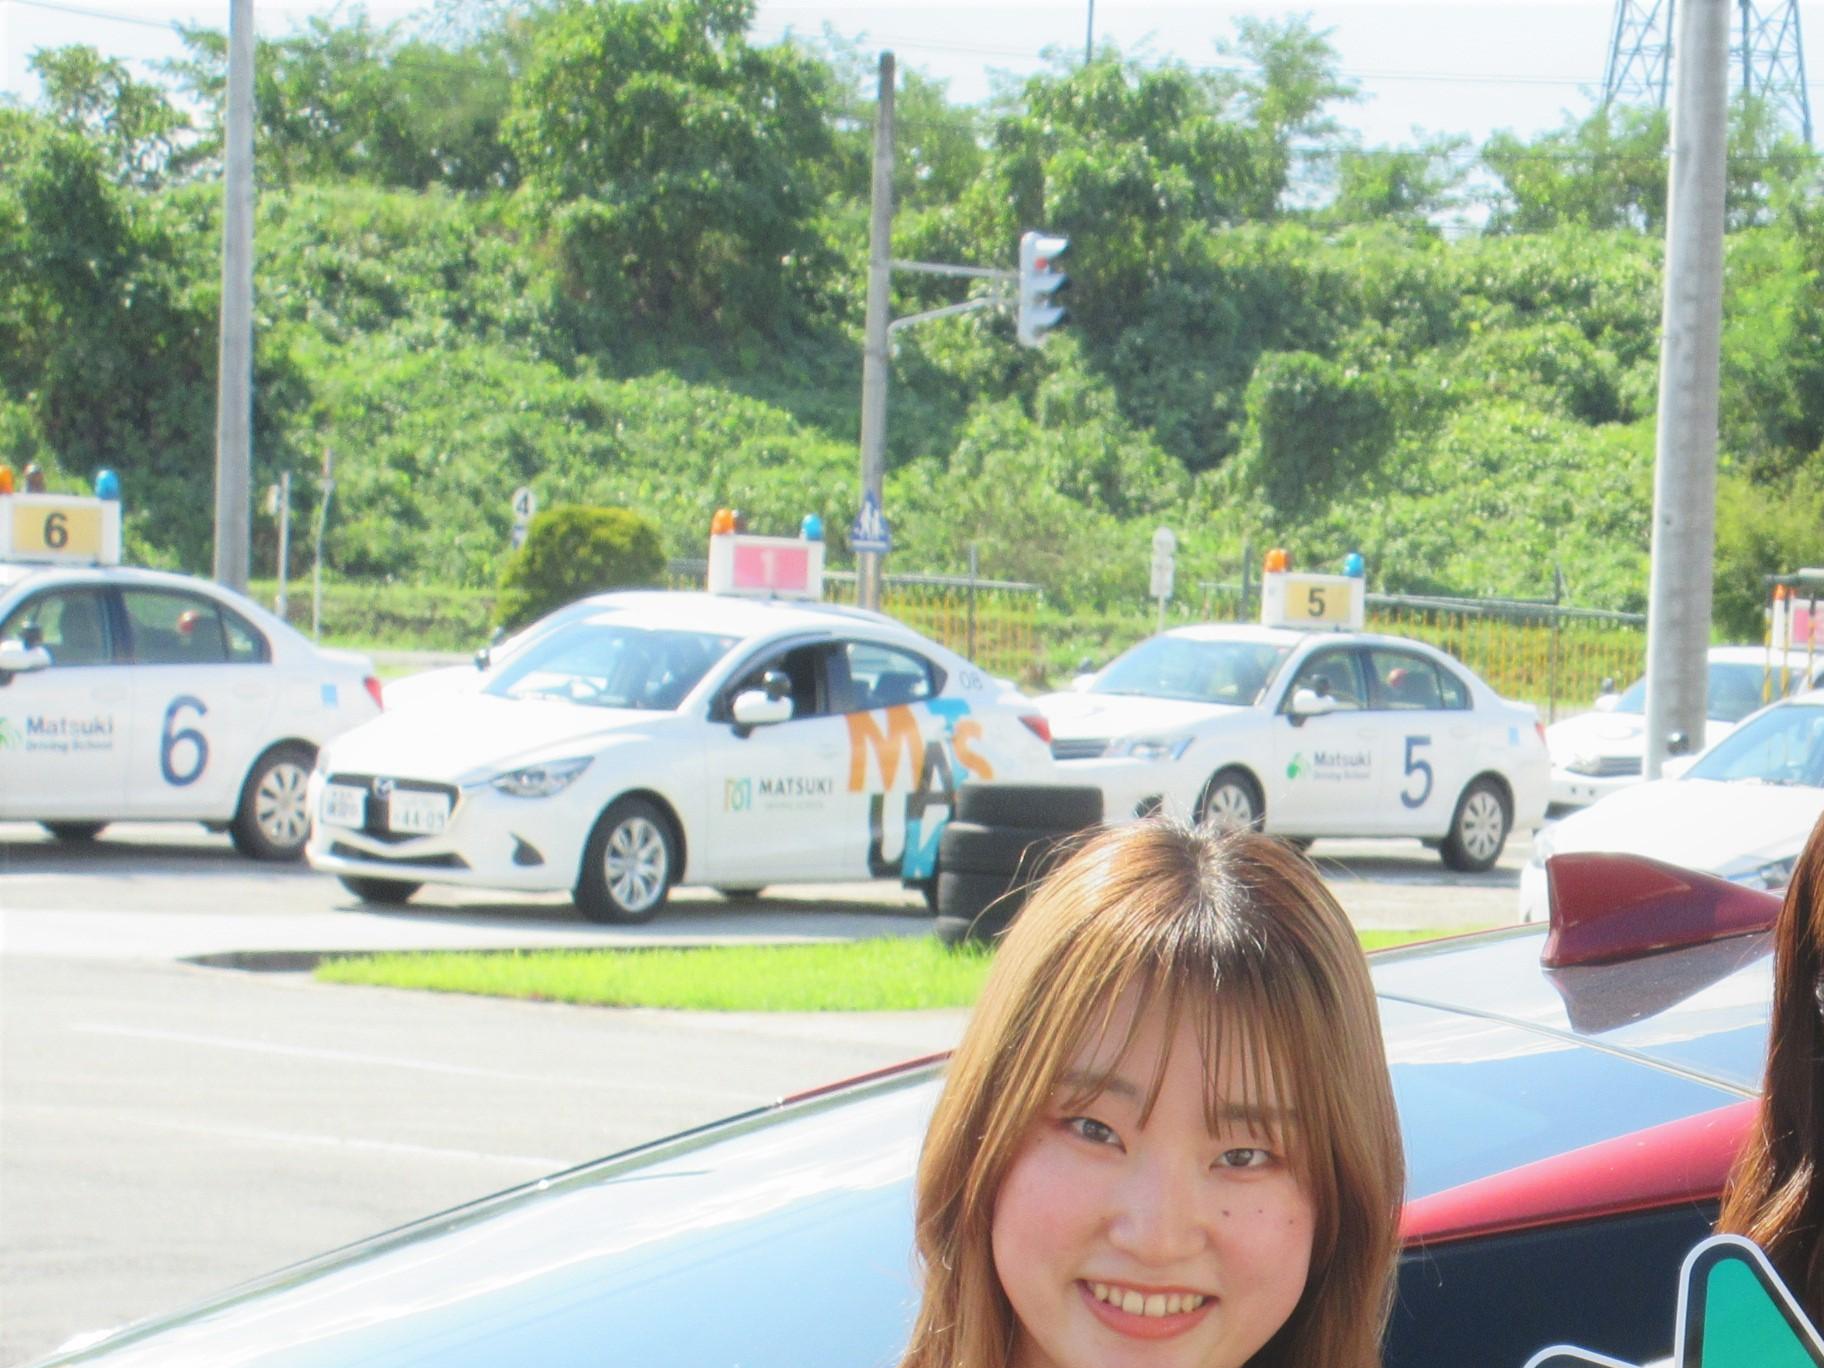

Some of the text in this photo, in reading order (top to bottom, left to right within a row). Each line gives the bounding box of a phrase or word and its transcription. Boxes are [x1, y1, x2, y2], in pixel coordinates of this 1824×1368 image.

[42, 512, 70, 549] 6
[1308, 587, 1326, 618] 5
[26, 714, 114, 735] Matsuki
[160, 695, 210, 787] 6
[1313, 751, 1372, 767] Matsuki
[1400, 735, 1434, 809] 5
[758, 776, 833, 796] MATSUKI
